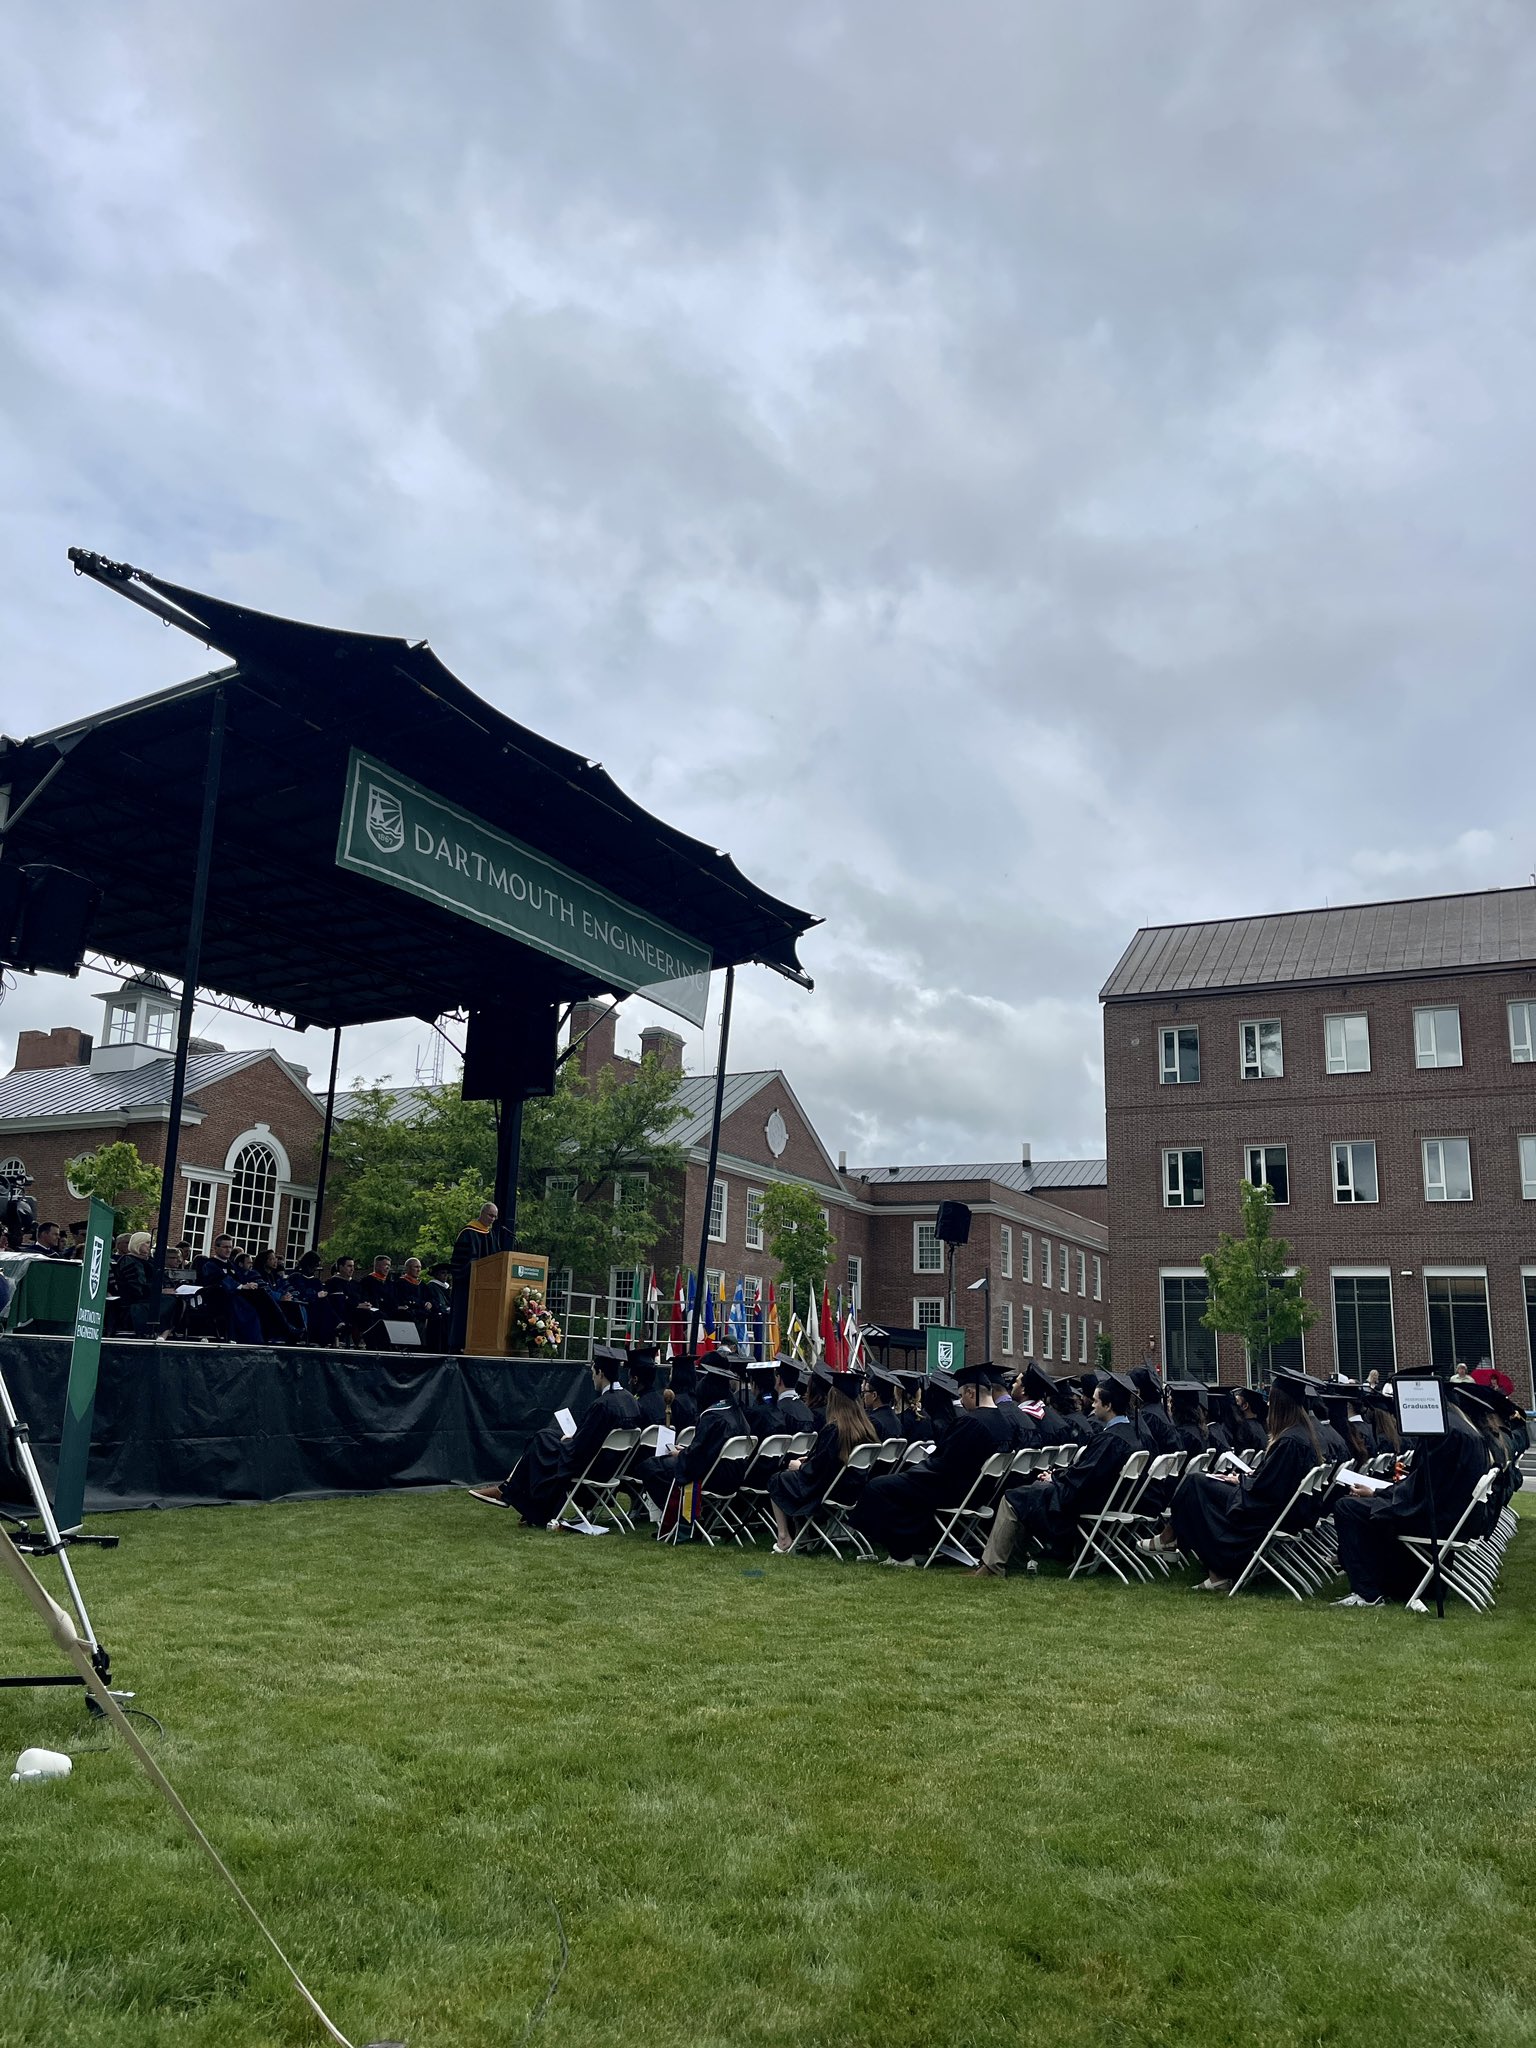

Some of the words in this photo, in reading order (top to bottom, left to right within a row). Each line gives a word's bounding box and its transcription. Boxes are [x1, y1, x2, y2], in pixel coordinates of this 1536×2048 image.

[377, 833, 393, 845] 1867
[414, 823, 575, 927] DARTMOUTH
[582, 910, 704, 992] ENGINEERING
